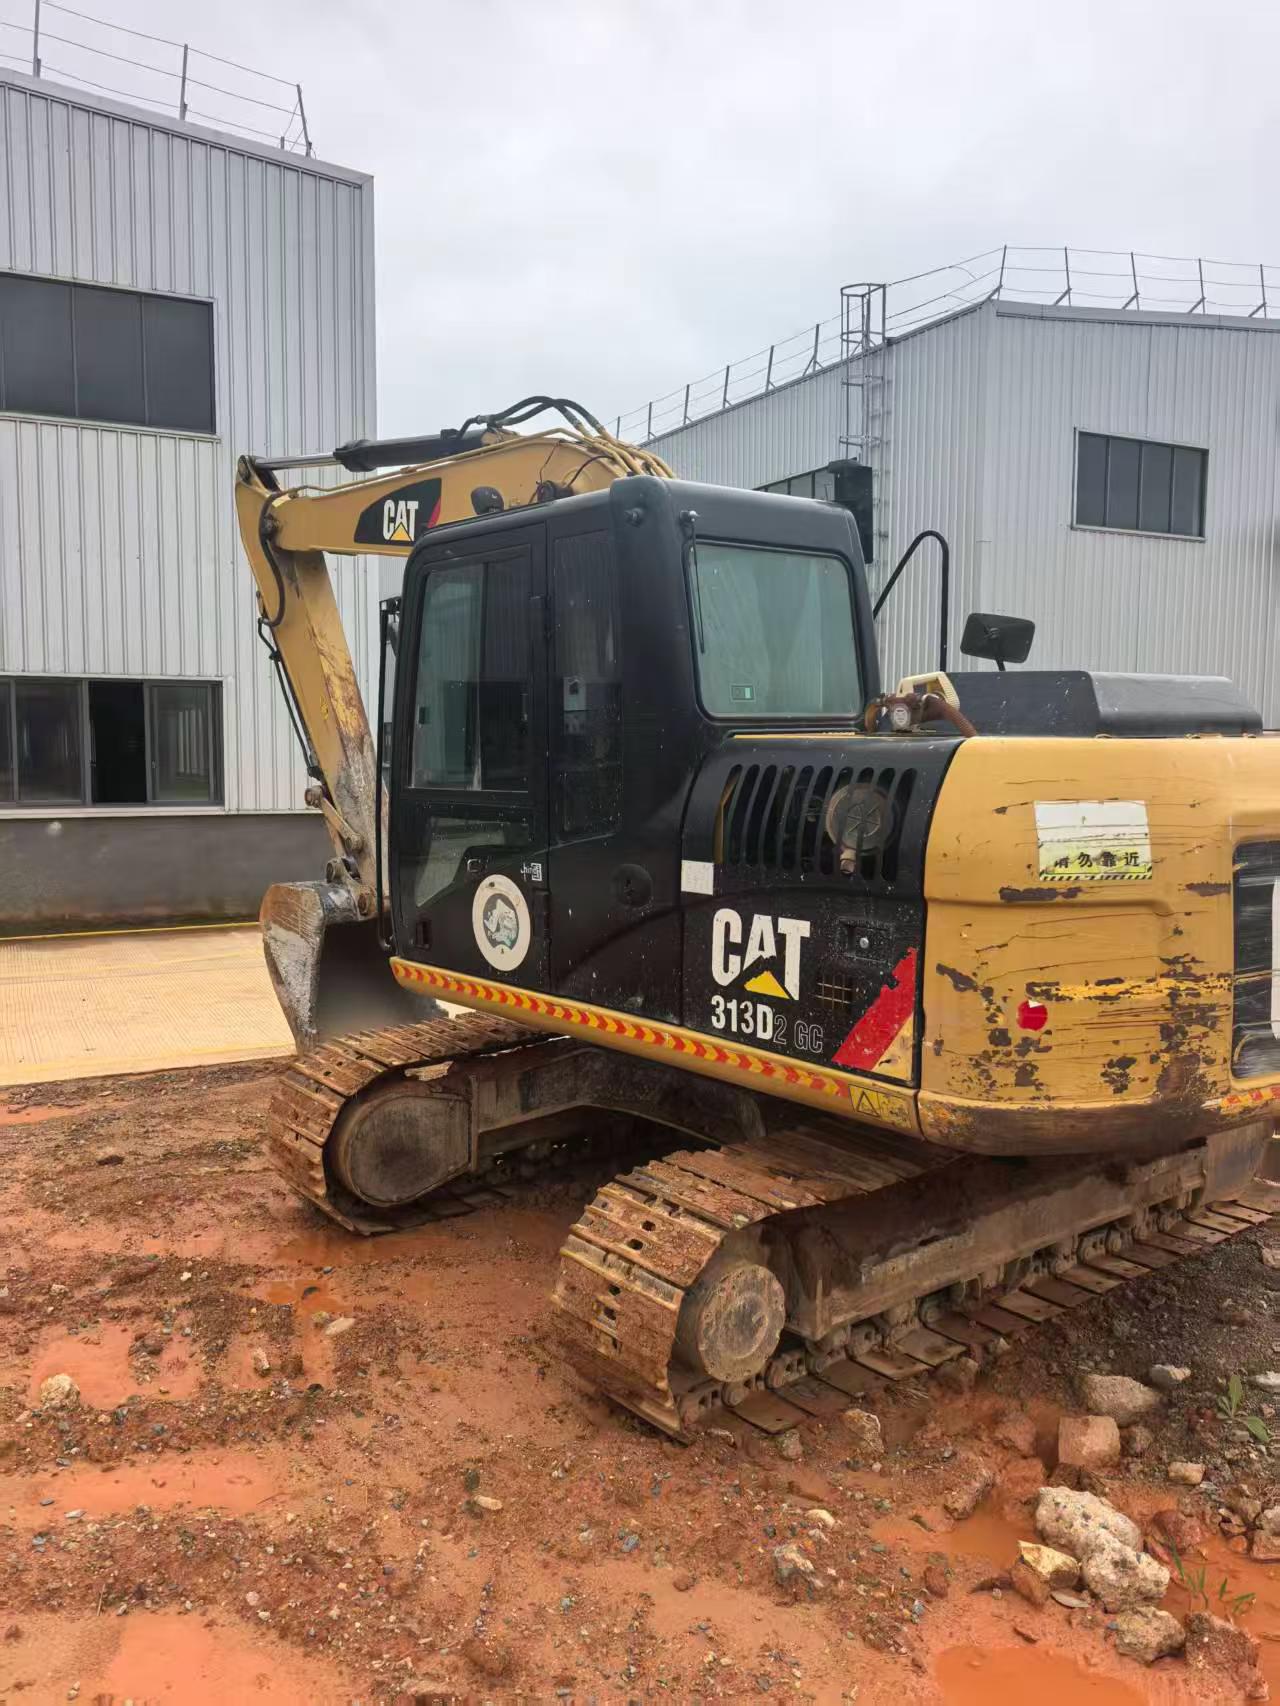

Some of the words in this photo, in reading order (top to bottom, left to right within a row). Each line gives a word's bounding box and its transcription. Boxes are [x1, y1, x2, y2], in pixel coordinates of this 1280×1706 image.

[383, 499, 419, 541] CAT
[712, 908, 811, 1001] CAT
[711, 995, 787, 1045] 313D2
[794, 1020, 824, 1053] GC
